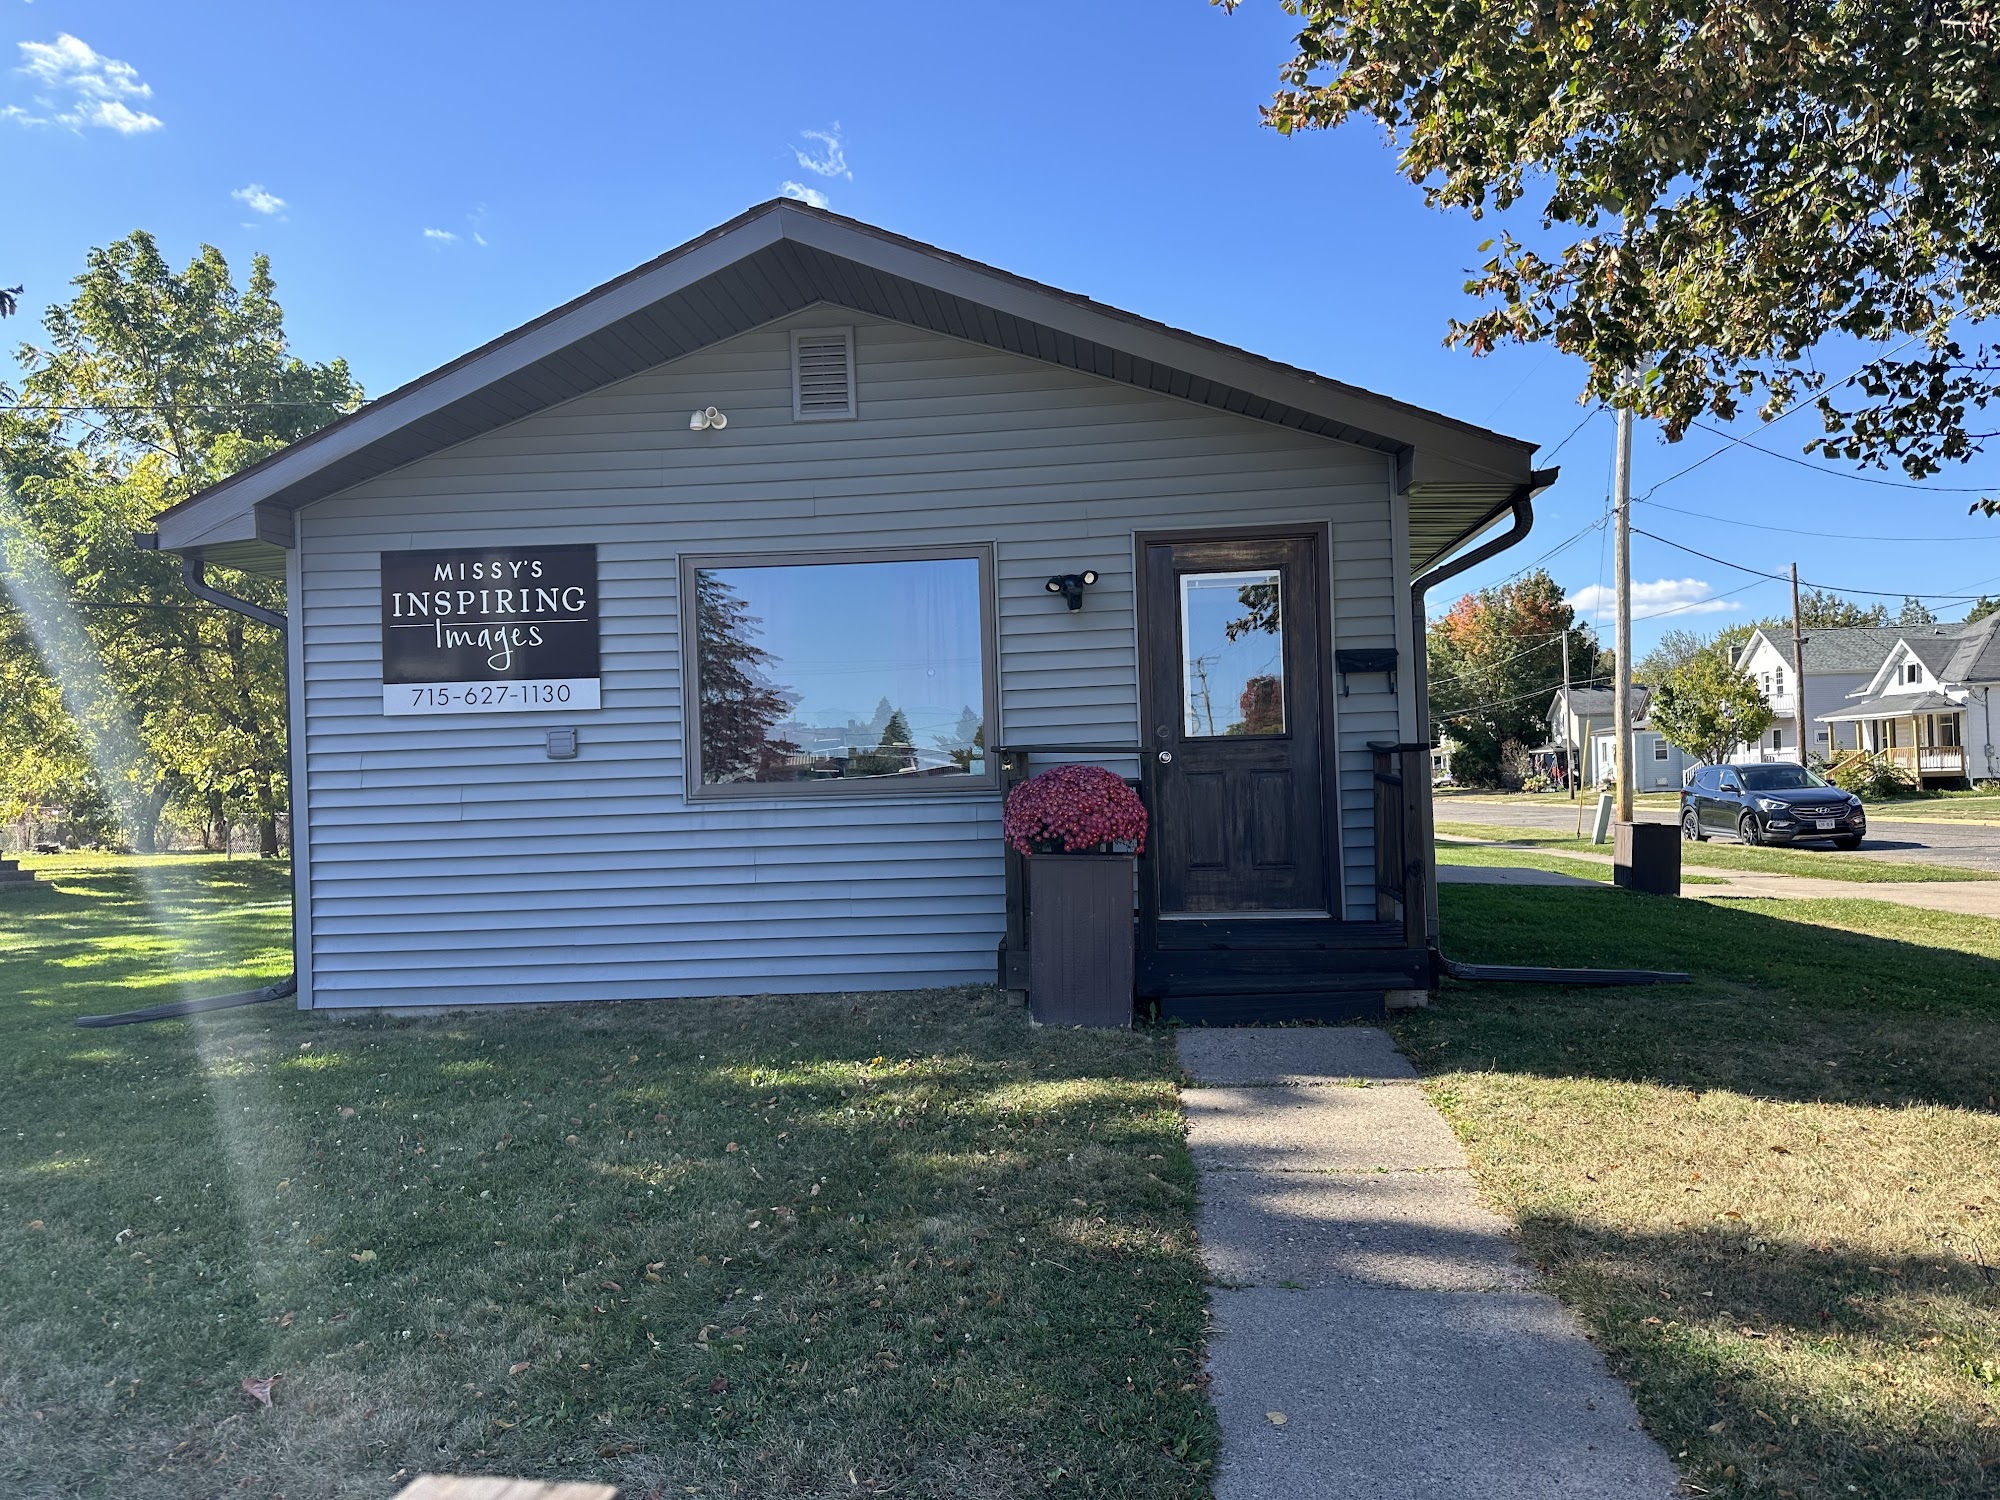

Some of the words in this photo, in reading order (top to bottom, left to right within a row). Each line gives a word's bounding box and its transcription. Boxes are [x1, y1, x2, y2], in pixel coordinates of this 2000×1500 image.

[434, 560, 543, 581] MISSY'S
[392, 586, 587, 617] INSPIRING
[435, 618, 544, 671] Images
[411, 684, 571, 706] 715-627-1130
